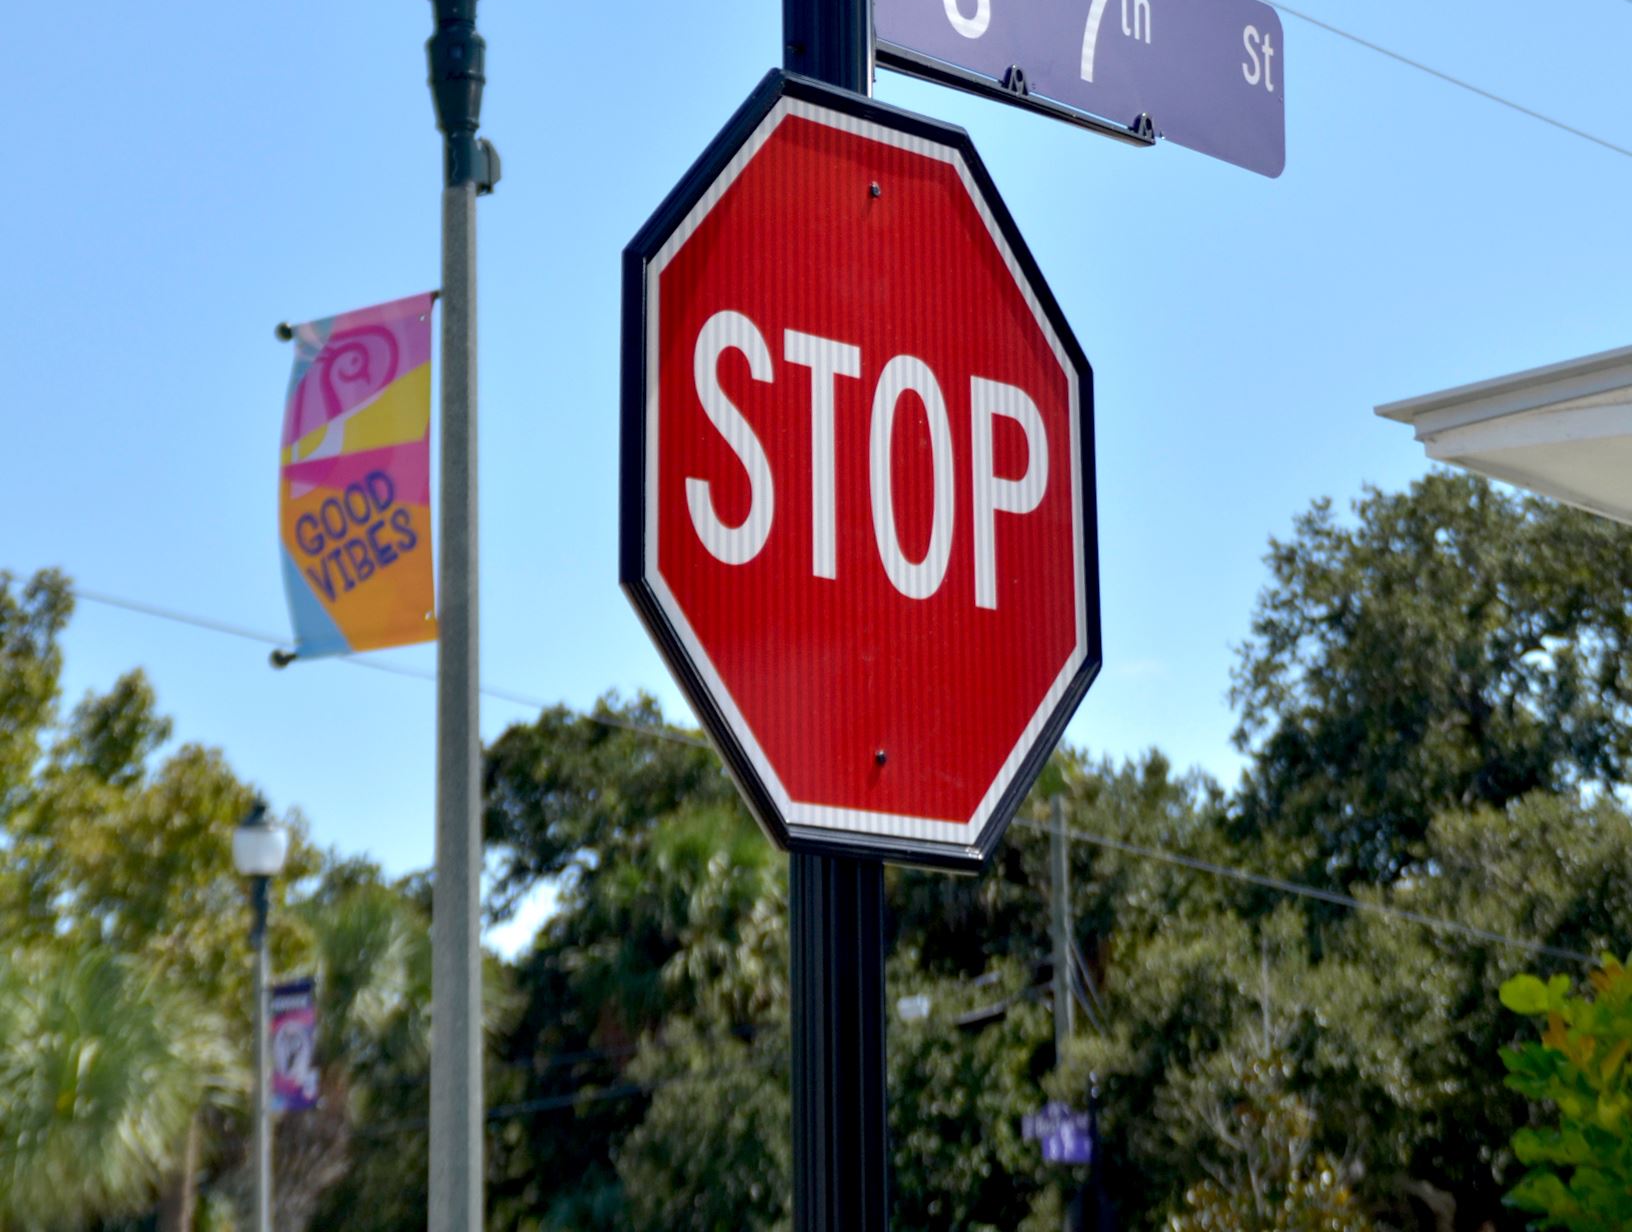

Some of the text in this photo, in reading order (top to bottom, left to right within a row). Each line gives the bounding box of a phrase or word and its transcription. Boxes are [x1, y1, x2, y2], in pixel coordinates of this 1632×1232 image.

[1241, 23, 1275, 93] St
[684, 309, 1050, 611] STOP
[295, 469, 395, 556] GOOD
[306, 507, 418, 602] VIBES
